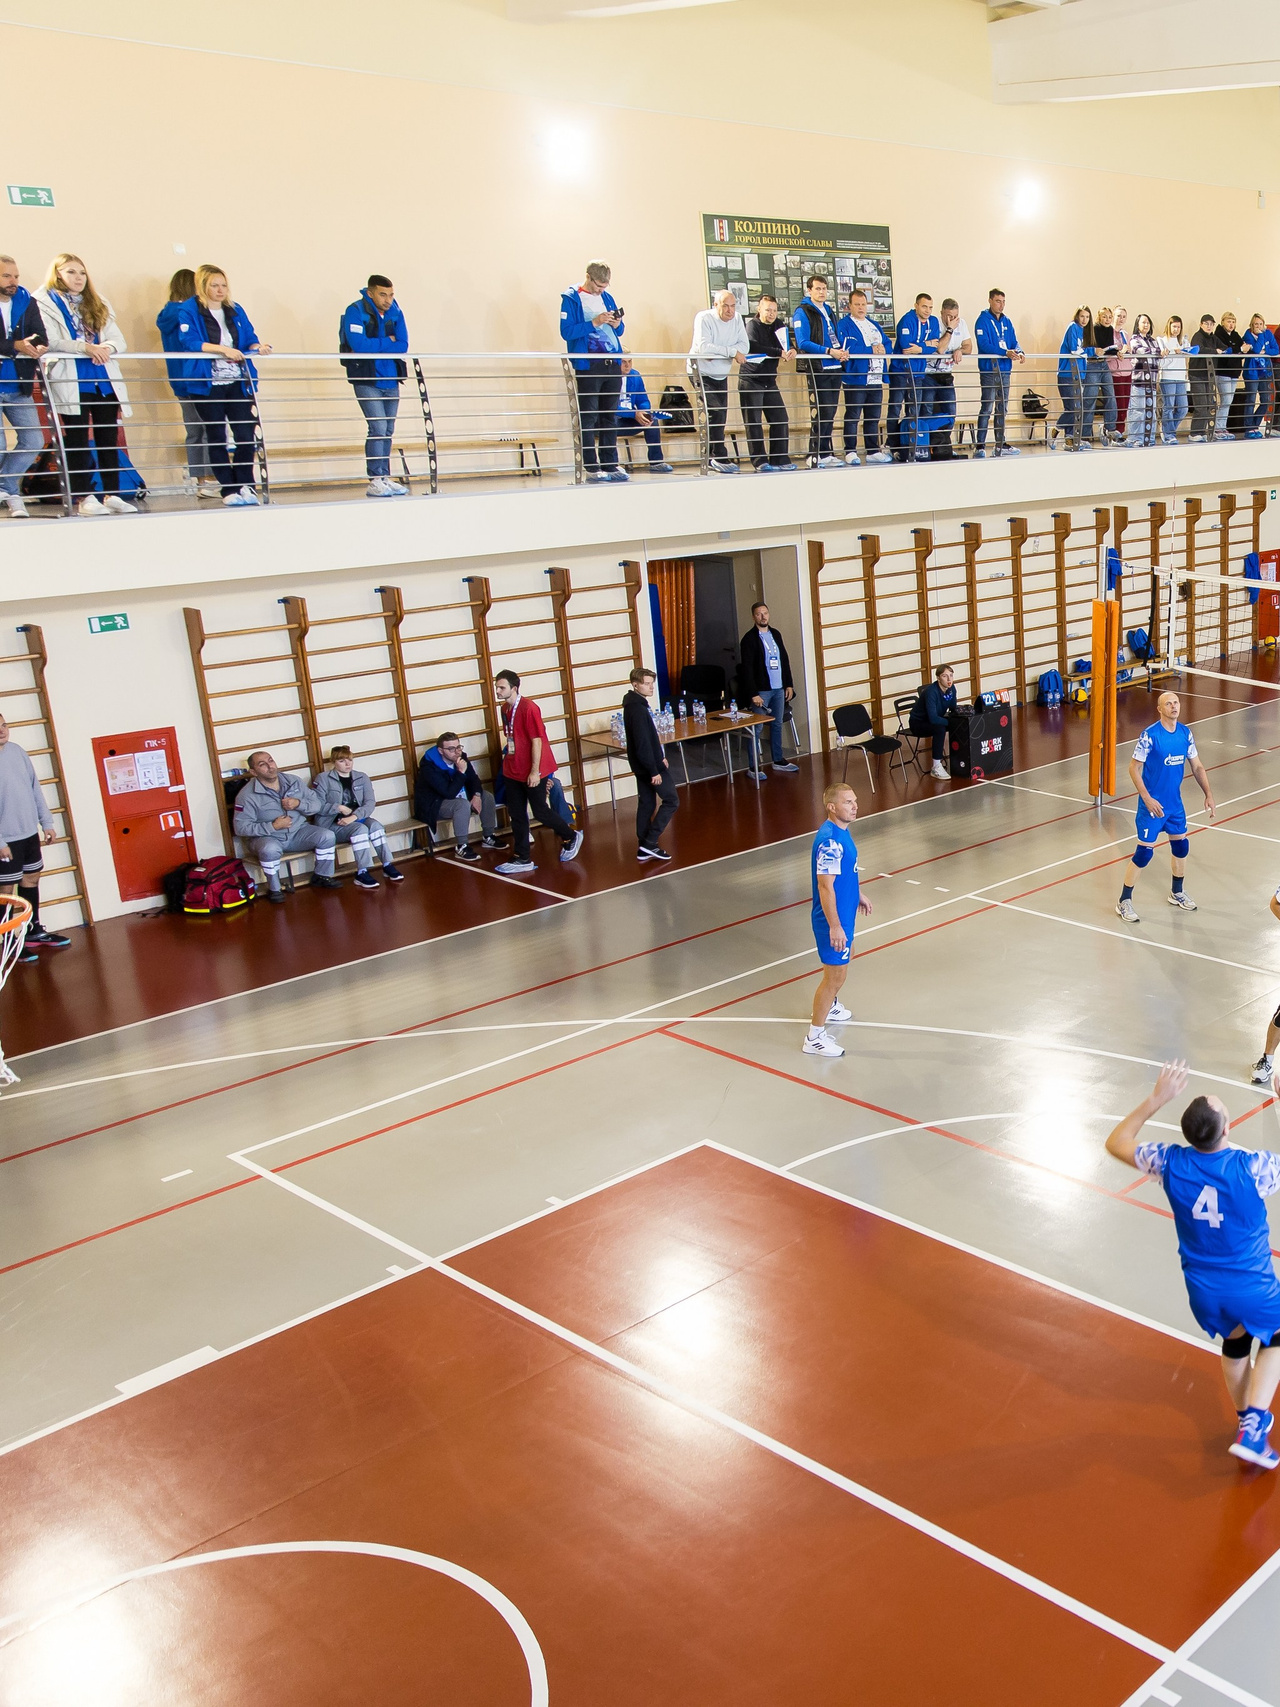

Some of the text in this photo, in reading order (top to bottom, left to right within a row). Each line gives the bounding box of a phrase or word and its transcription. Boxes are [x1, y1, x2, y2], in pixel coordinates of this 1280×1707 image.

[734, 220, 800, 236] КОЛПИНО
[735, 235, 761, 245] ГОРОД
[762, 236, 805, 247] ВОИНСКОЙ
[806, 239, 833, 247] СЛАВЫ
[983, 694, 994, 704] 22
[1001, 691, 1010, 702] 10
[981, 737, 1003, 748] WORK
[981, 744, 1003, 756] SPORT
[1143, 828, 1149, 838] 1
[841, 947, 850, 960] 2
[1192, 1184, 1224, 1229] 4
